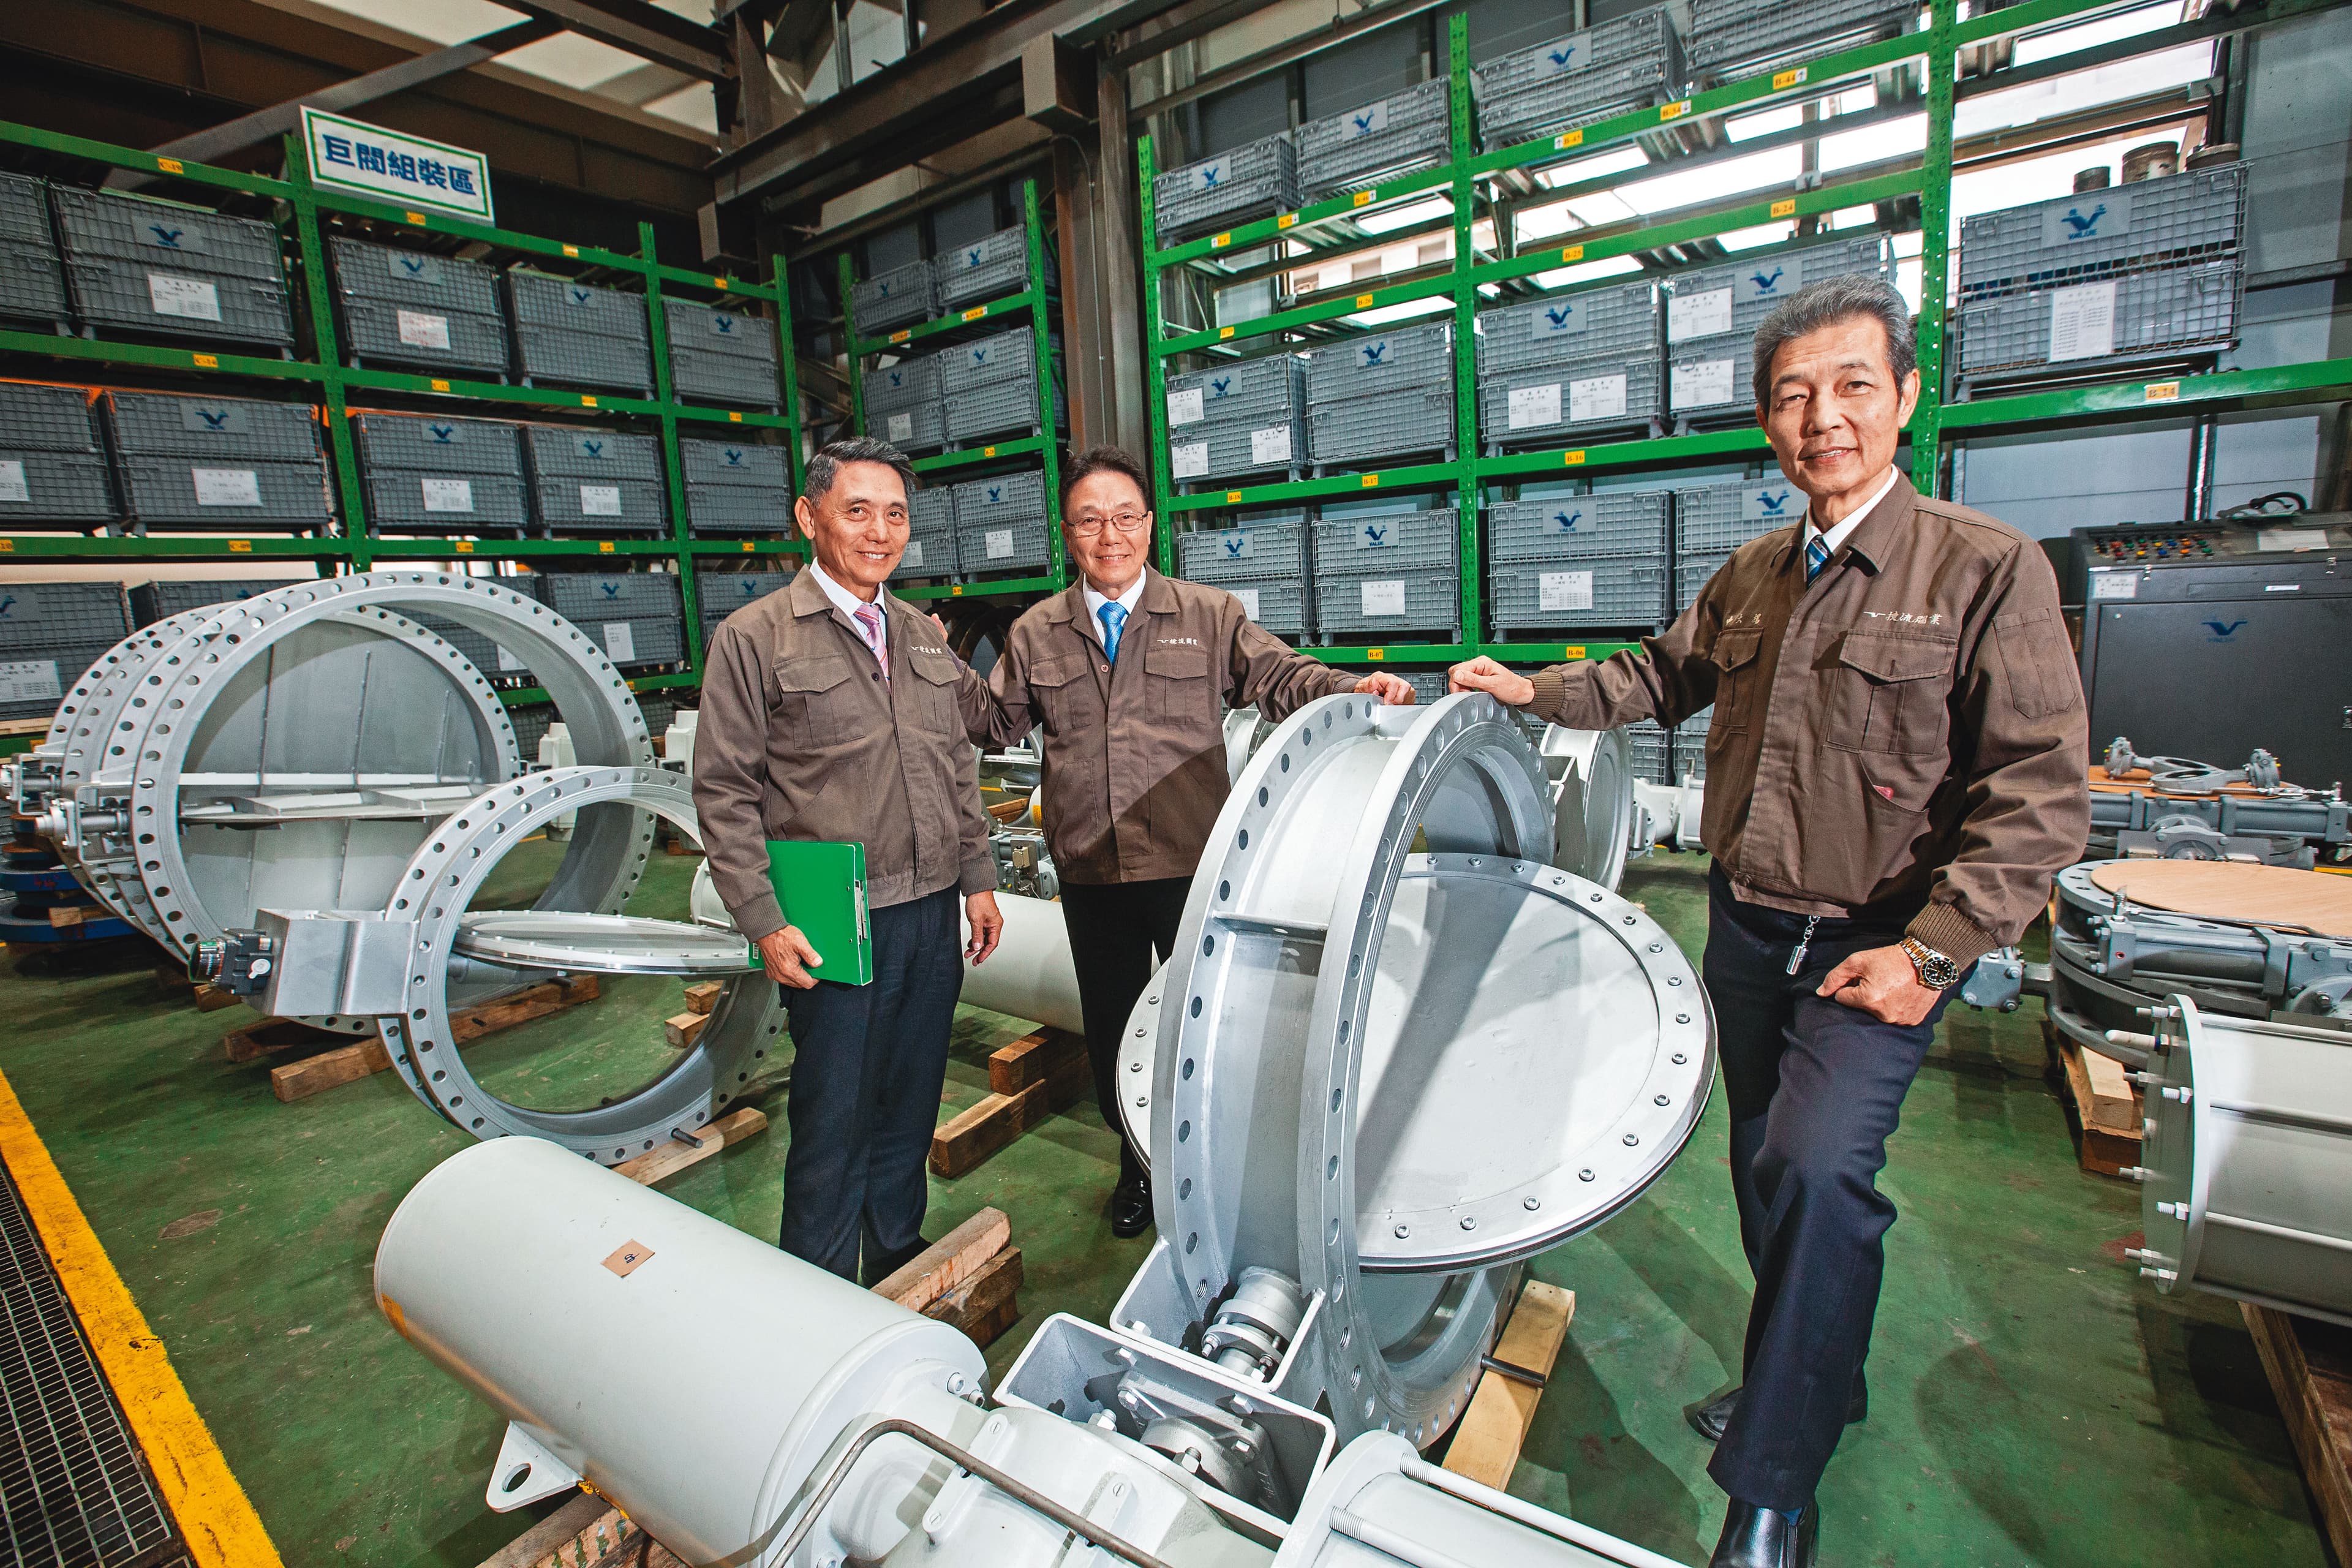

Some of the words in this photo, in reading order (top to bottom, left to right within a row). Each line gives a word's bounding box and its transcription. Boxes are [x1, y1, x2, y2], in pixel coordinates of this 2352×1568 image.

[1776, 74, 1795, 85] B-44
[322, 134, 477, 196] 巨閥組裝區
[1773, 204, 1793, 214] B-24
